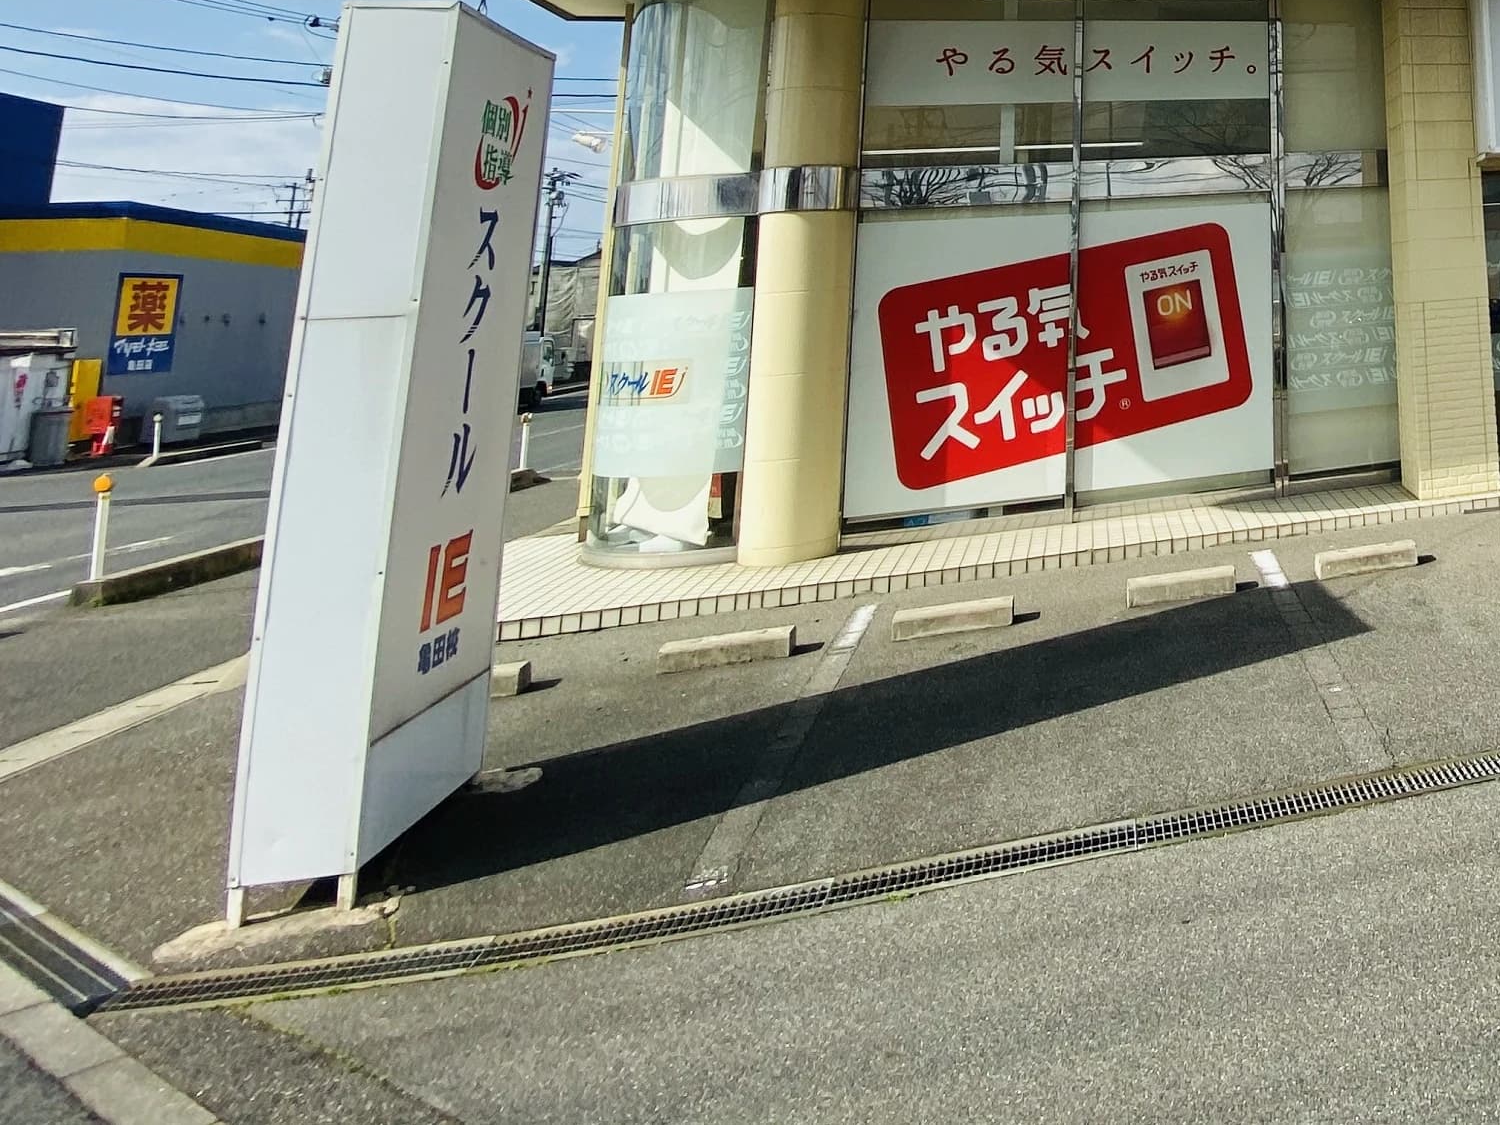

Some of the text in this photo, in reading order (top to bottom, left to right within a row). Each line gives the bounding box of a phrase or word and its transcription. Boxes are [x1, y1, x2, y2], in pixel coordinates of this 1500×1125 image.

[936, 44, 1257, 76] やる気スイッチ。
[482, 99, 512, 143] 個別
[484, 143, 514, 185] 指導
[1138, 261, 1199, 283] やる気スイッチ
[127, 280, 170, 333] 薬
[1157, 289, 1193, 316] ON
[914, 282, 1090, 372] やる気
[915, 348, 1128, 461] スイッチ
